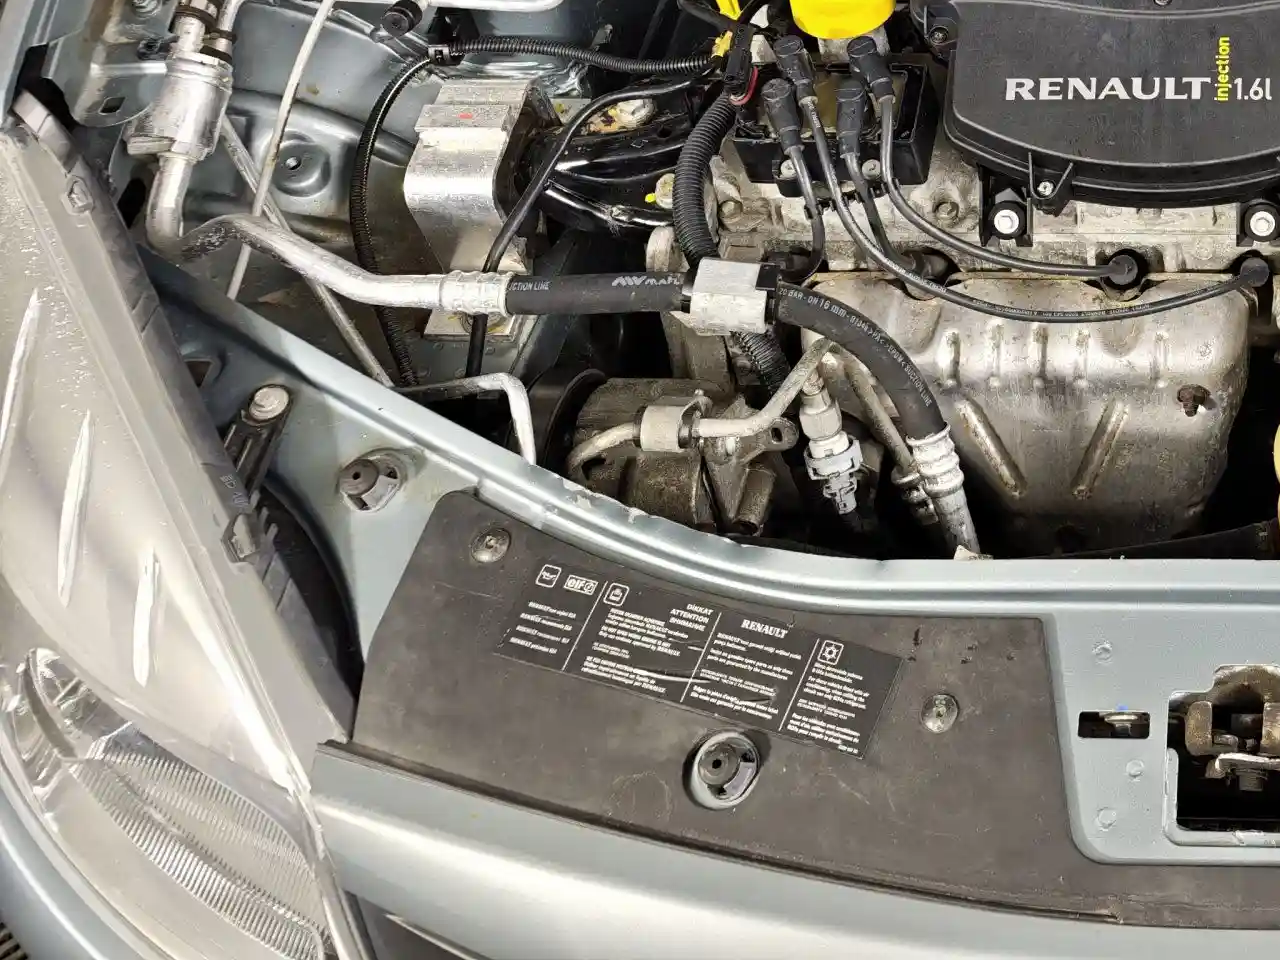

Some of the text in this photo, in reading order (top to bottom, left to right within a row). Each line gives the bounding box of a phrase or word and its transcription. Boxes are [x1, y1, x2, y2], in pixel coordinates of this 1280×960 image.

[1214, 36, 1232, 101] injection
[1005, 77, 1272, 101] RENAULT 1.6l
[819, 297, 830, 310] 16
[670, 608, 710, 623] ATTENTION
[740, 619, 789, 639] RENAULT
